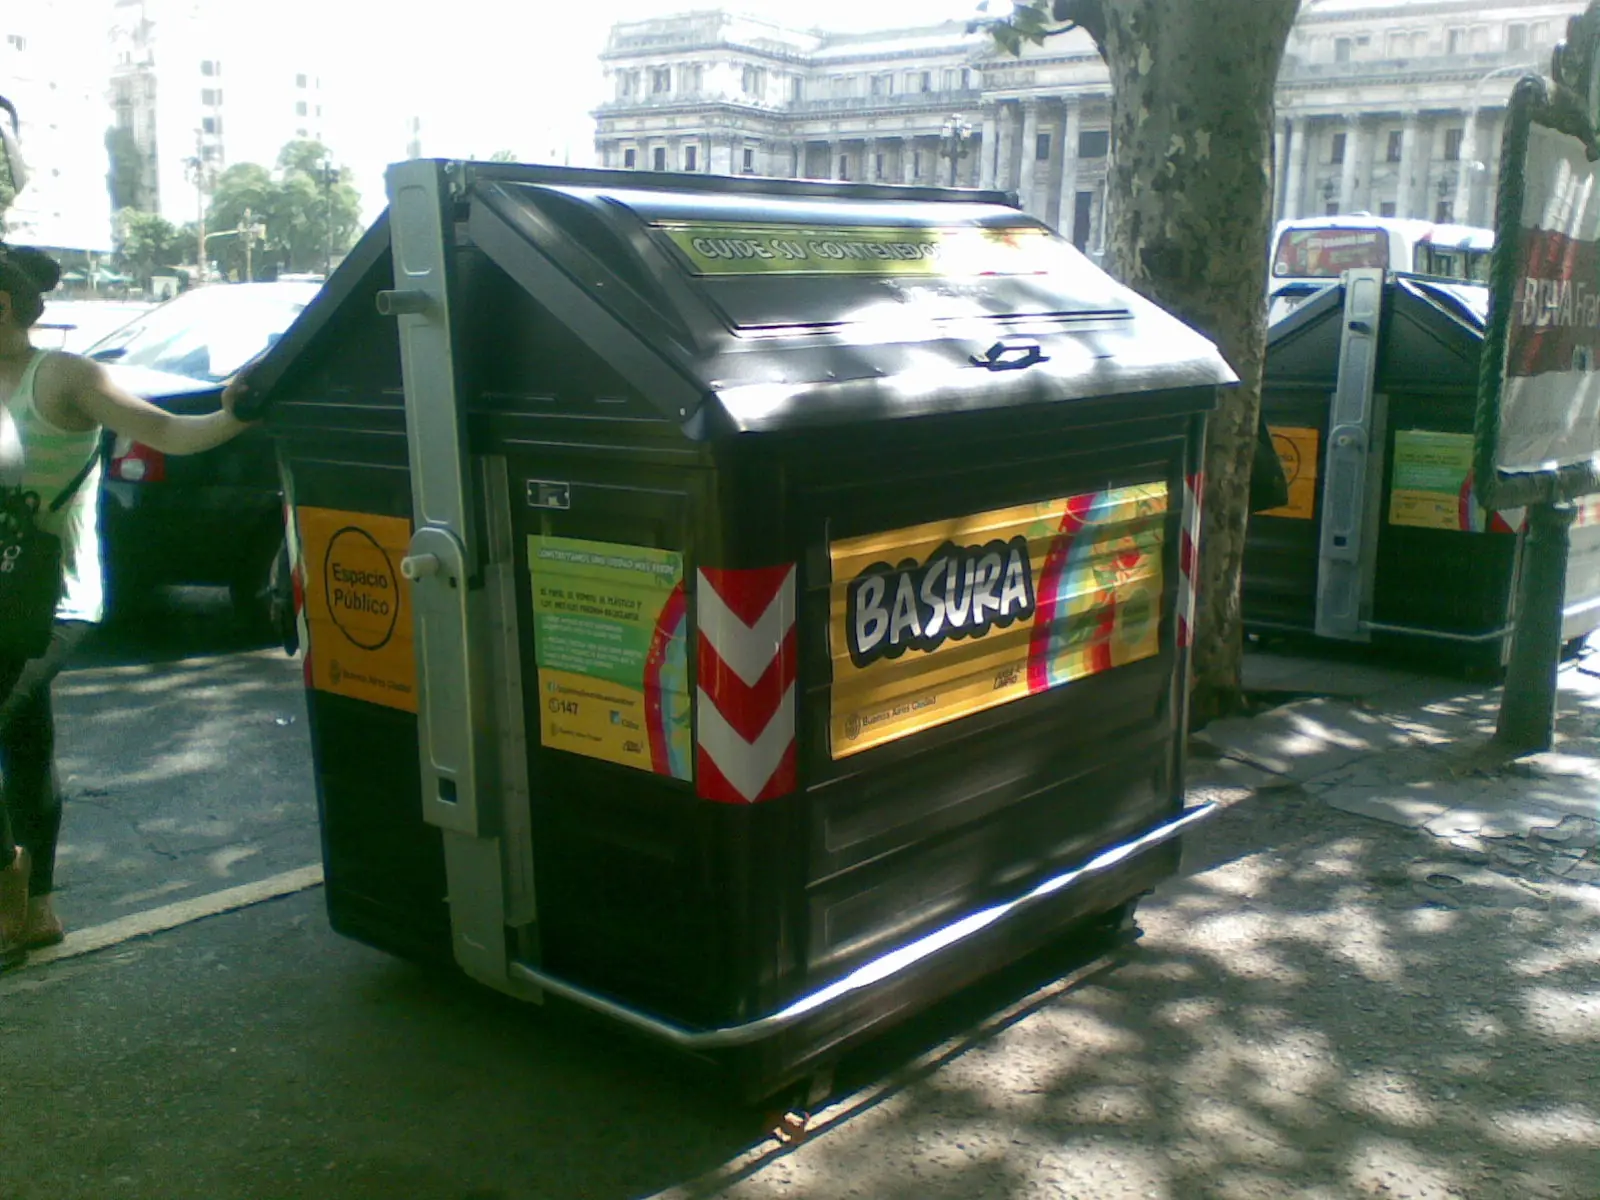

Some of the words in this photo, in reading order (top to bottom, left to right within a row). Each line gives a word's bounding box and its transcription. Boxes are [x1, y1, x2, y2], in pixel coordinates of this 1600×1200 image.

[692, 236, 774, 260] CUIDE
[774, 237, 807, 261] SU
[332, 562, 388, 589] Espacio
[333, 588, 389, 616] Público
[856, 548, 1028, 653] BASURA
[560, 700, 579, 715] 147
